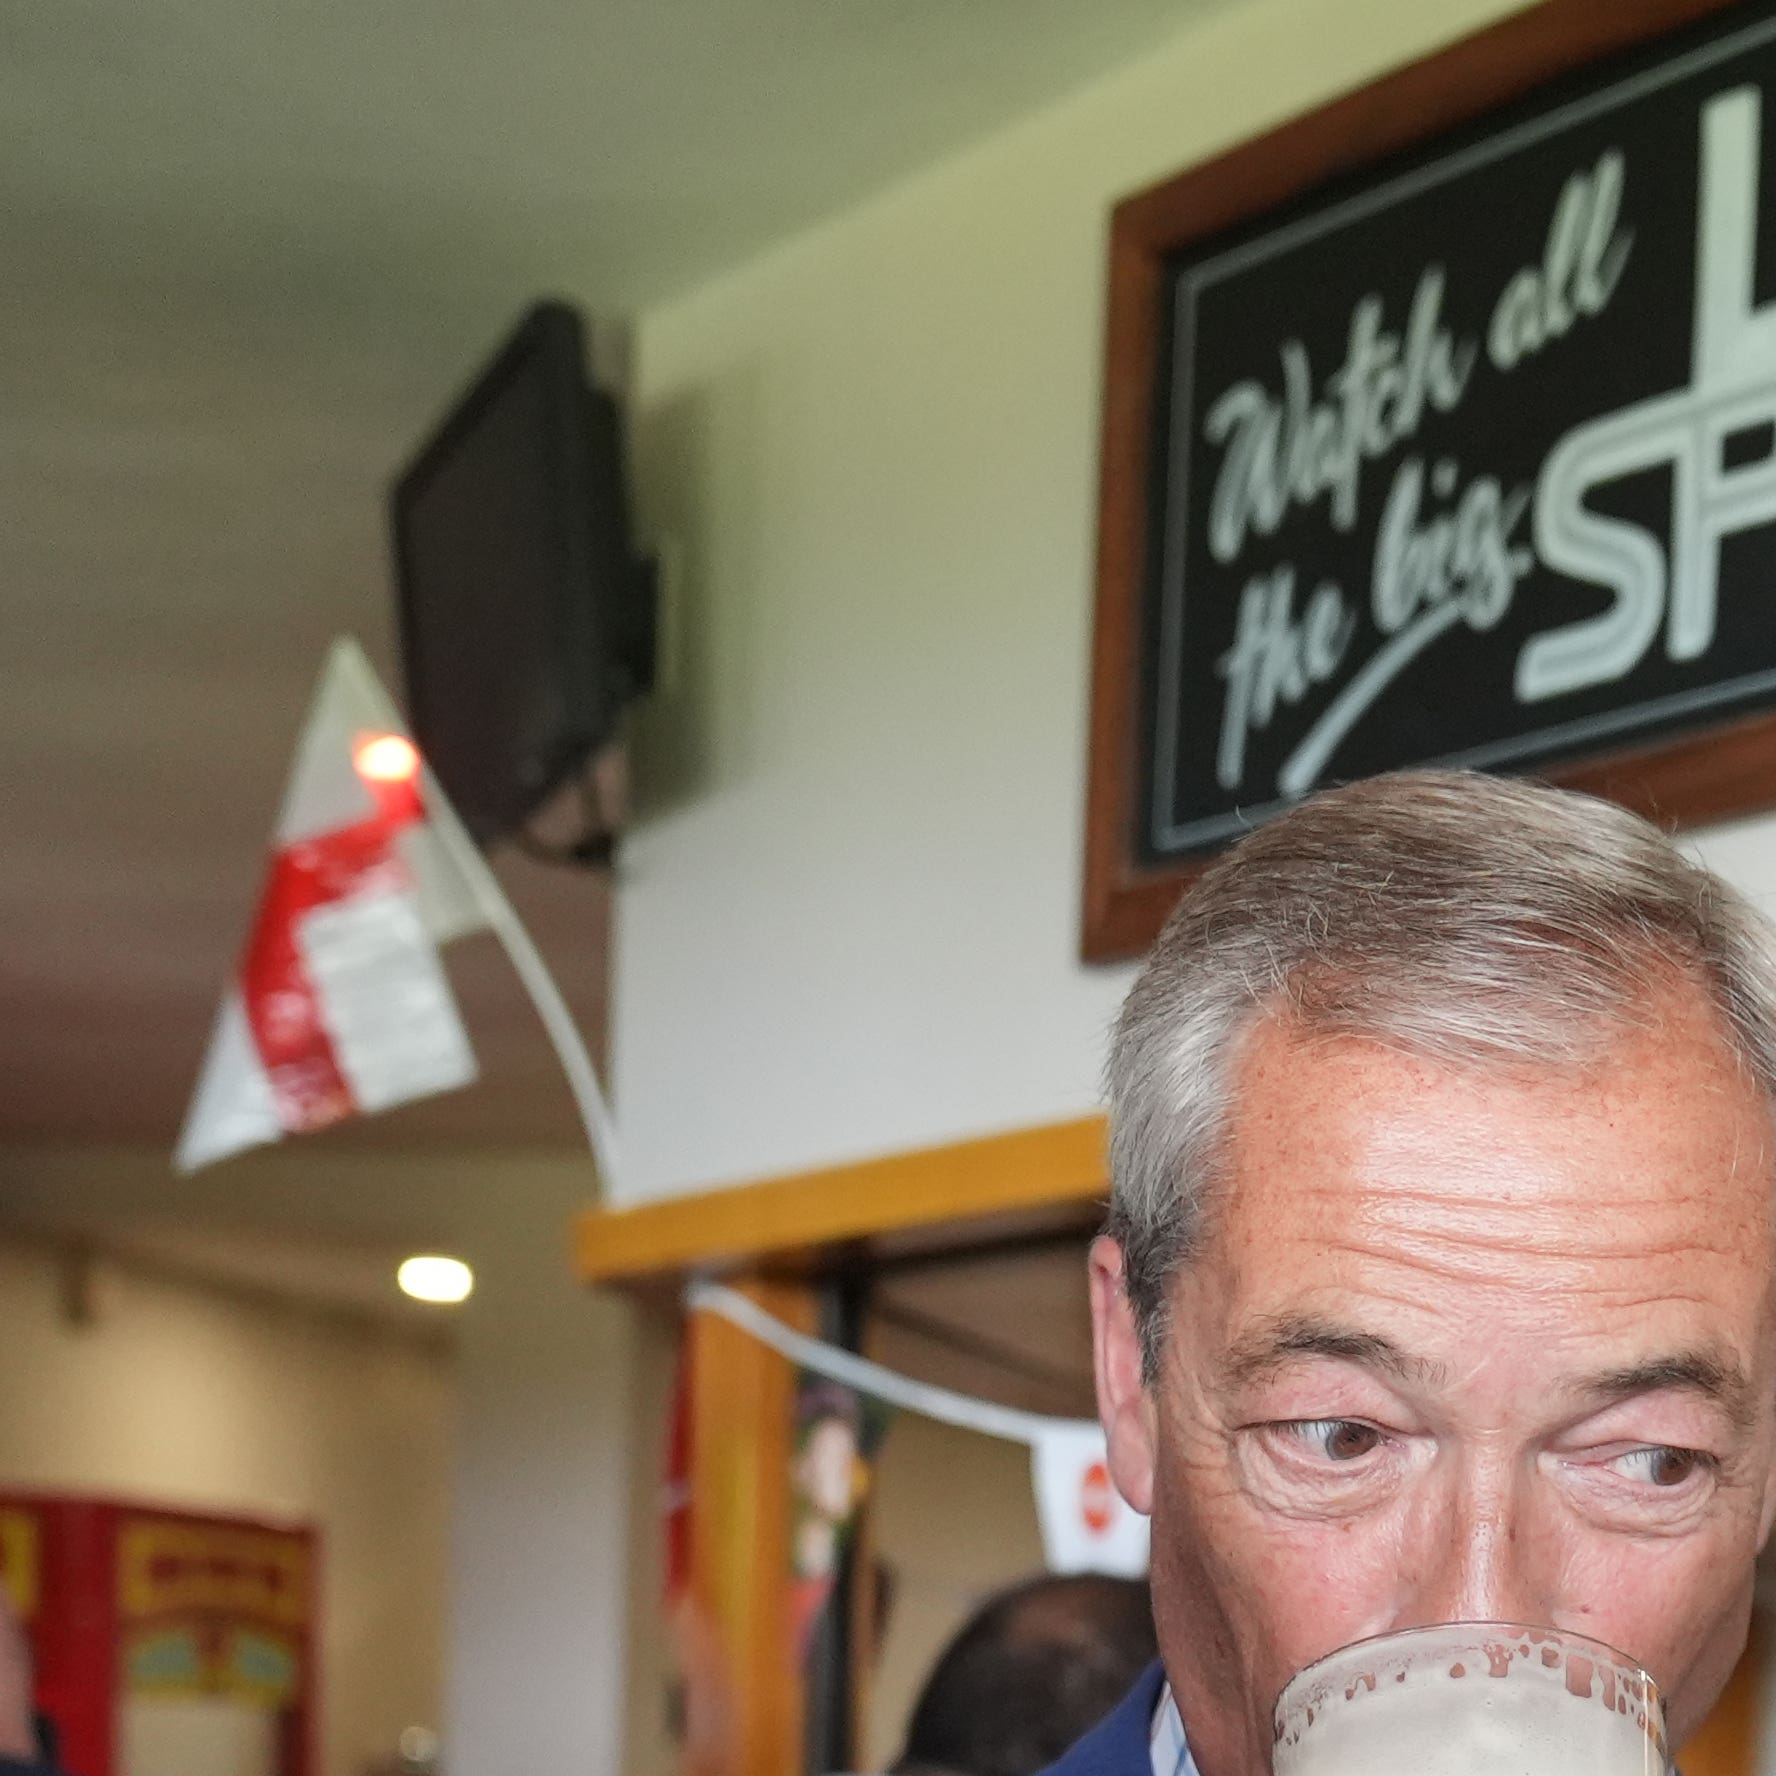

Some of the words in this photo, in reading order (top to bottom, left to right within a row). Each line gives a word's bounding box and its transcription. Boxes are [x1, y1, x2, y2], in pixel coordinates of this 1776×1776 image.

[1205, 260, 1477, 562] Watch
[1487, 148, 1636, 369] all
[1216, 563, 1356, 790] the
[1371, 456, 1534, 633] big
